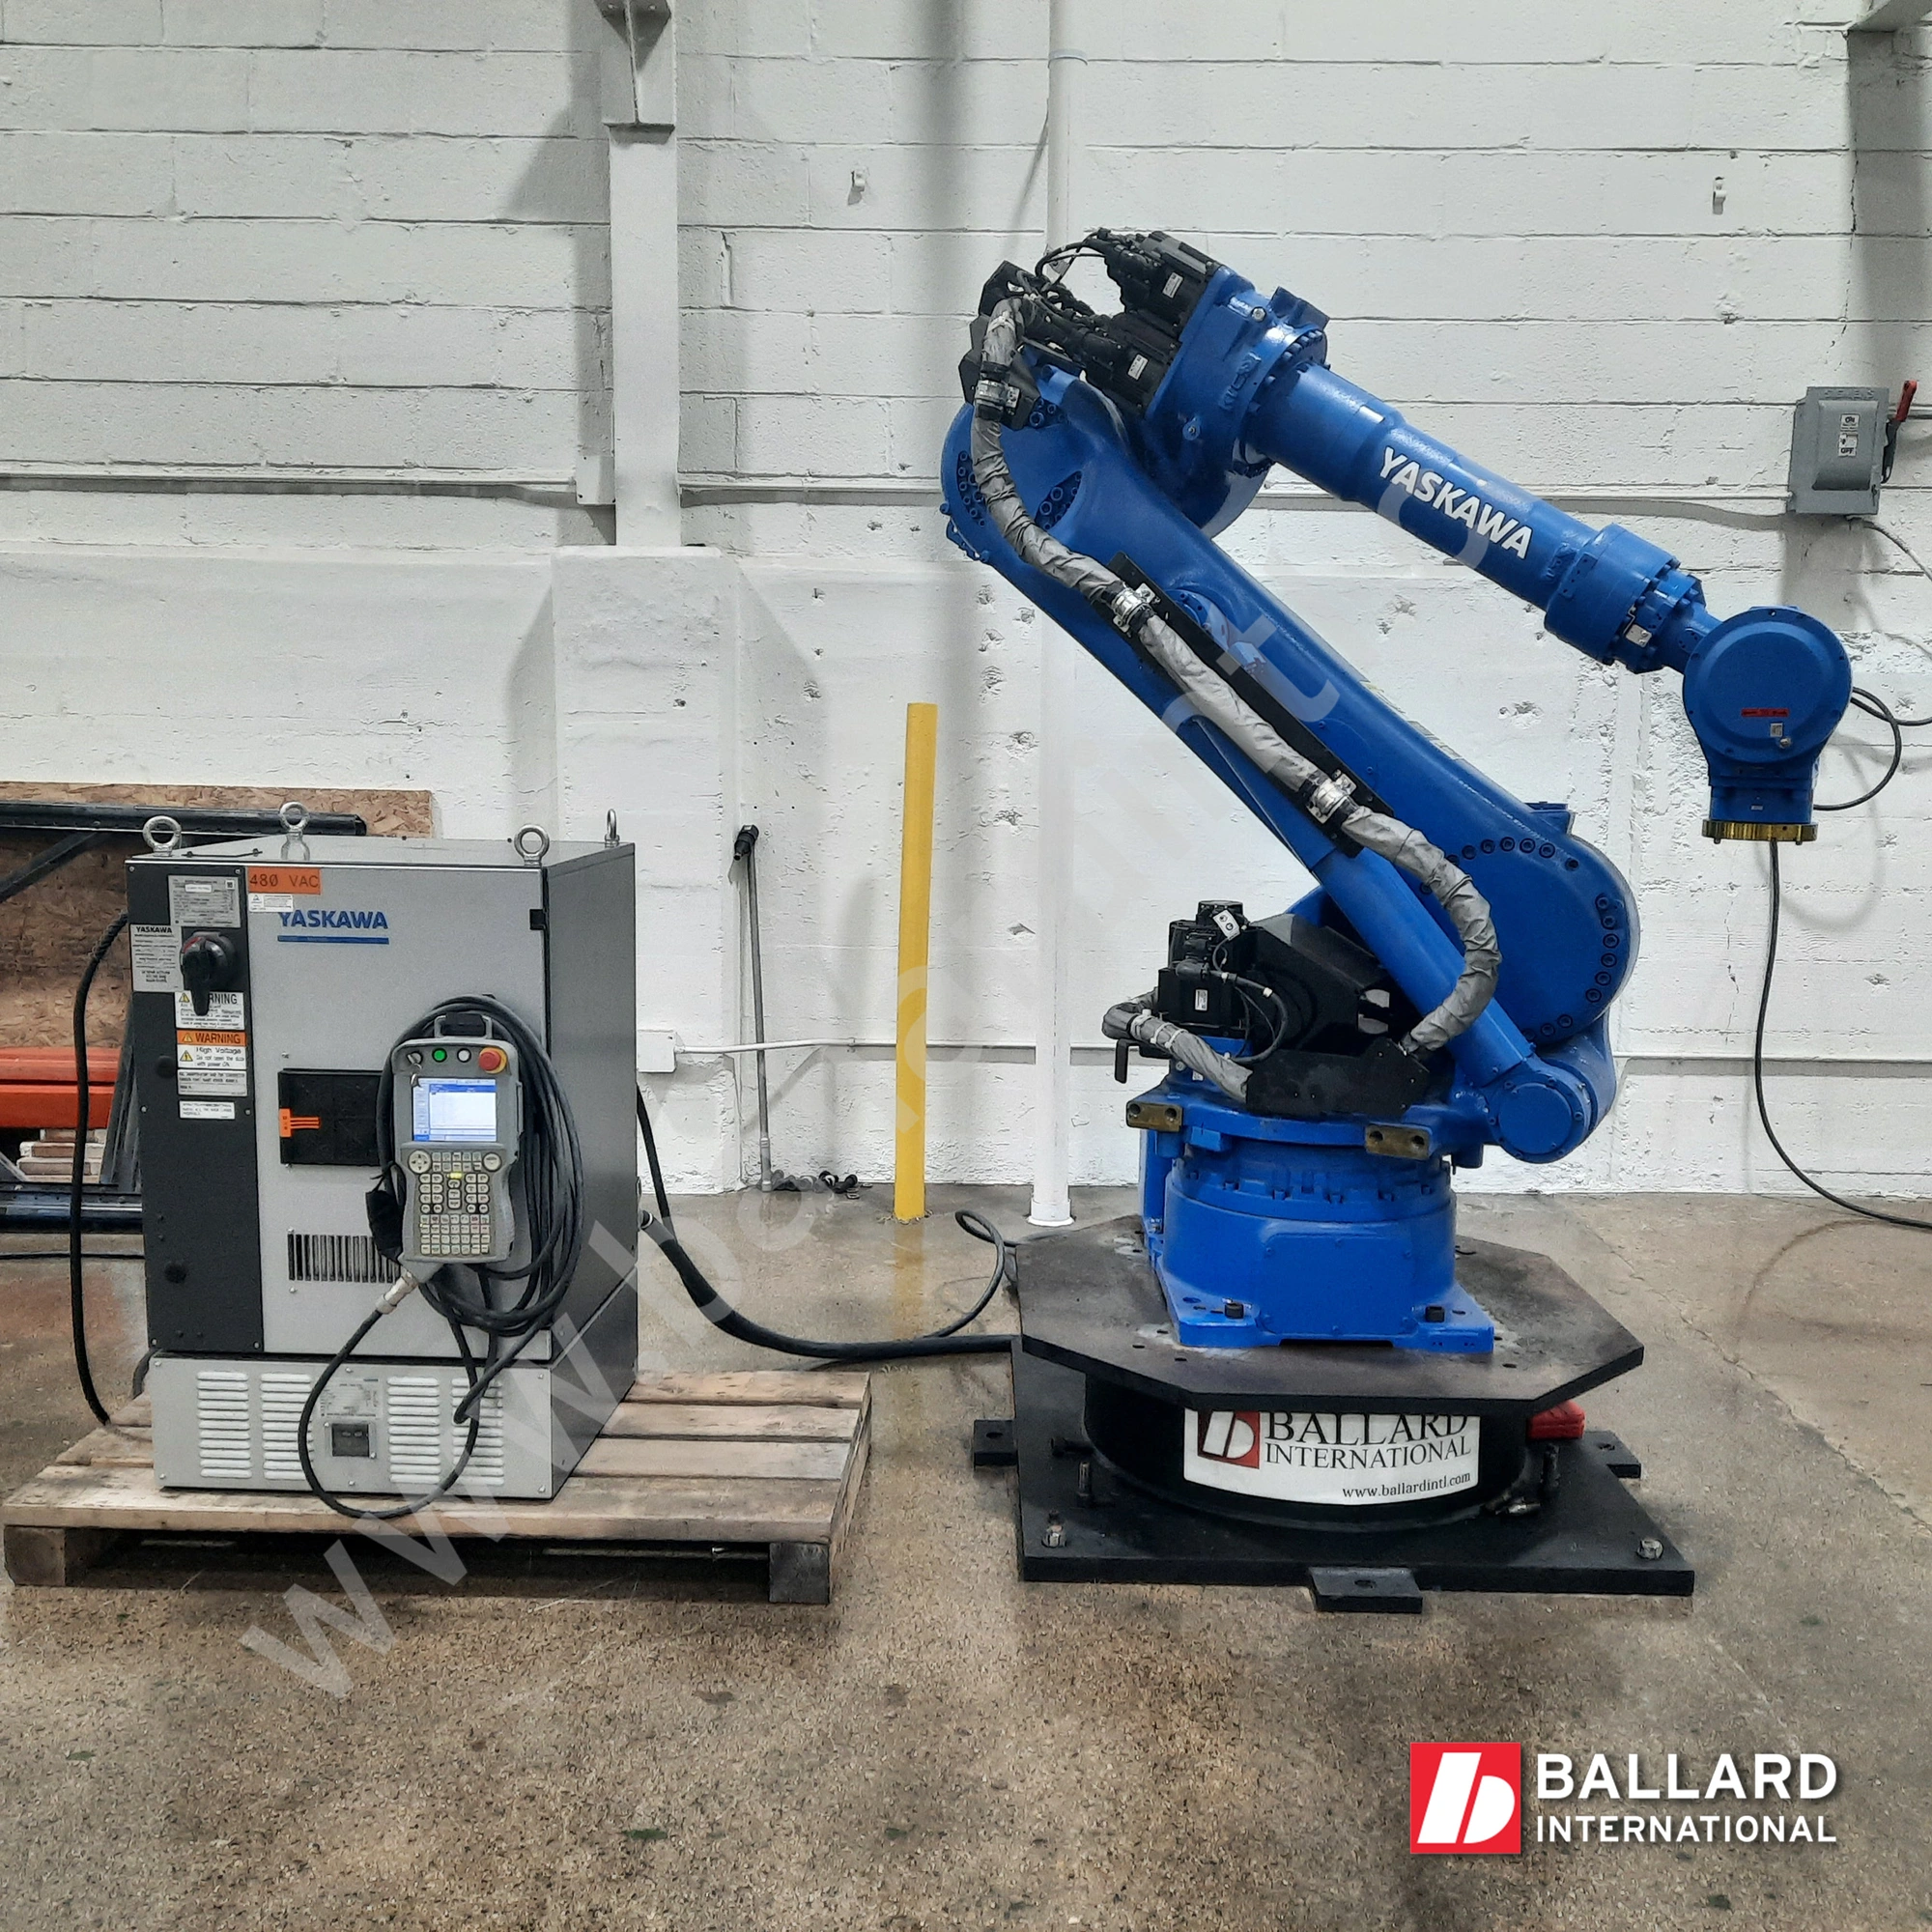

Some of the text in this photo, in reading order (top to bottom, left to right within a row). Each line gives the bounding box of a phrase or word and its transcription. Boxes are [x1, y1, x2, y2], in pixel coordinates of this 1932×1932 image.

[1824, 389, 1875, 399] SEES
[1378, 445, 1532, 559] YASKAWA
[249, 873, 319, 888] 480 VAC
[278, 909, 388, 929] YASKAWA
[195, 1033, 241, 1044] WARNING
[196, 1046, 213, 1055] High
[1266, 1411, 1467, 1445] BALLARD
[1265, 1435, 1471, 1469] INTERNATIONAL
[1342, 1471, 1471, 1498] www.ballardintl.com
